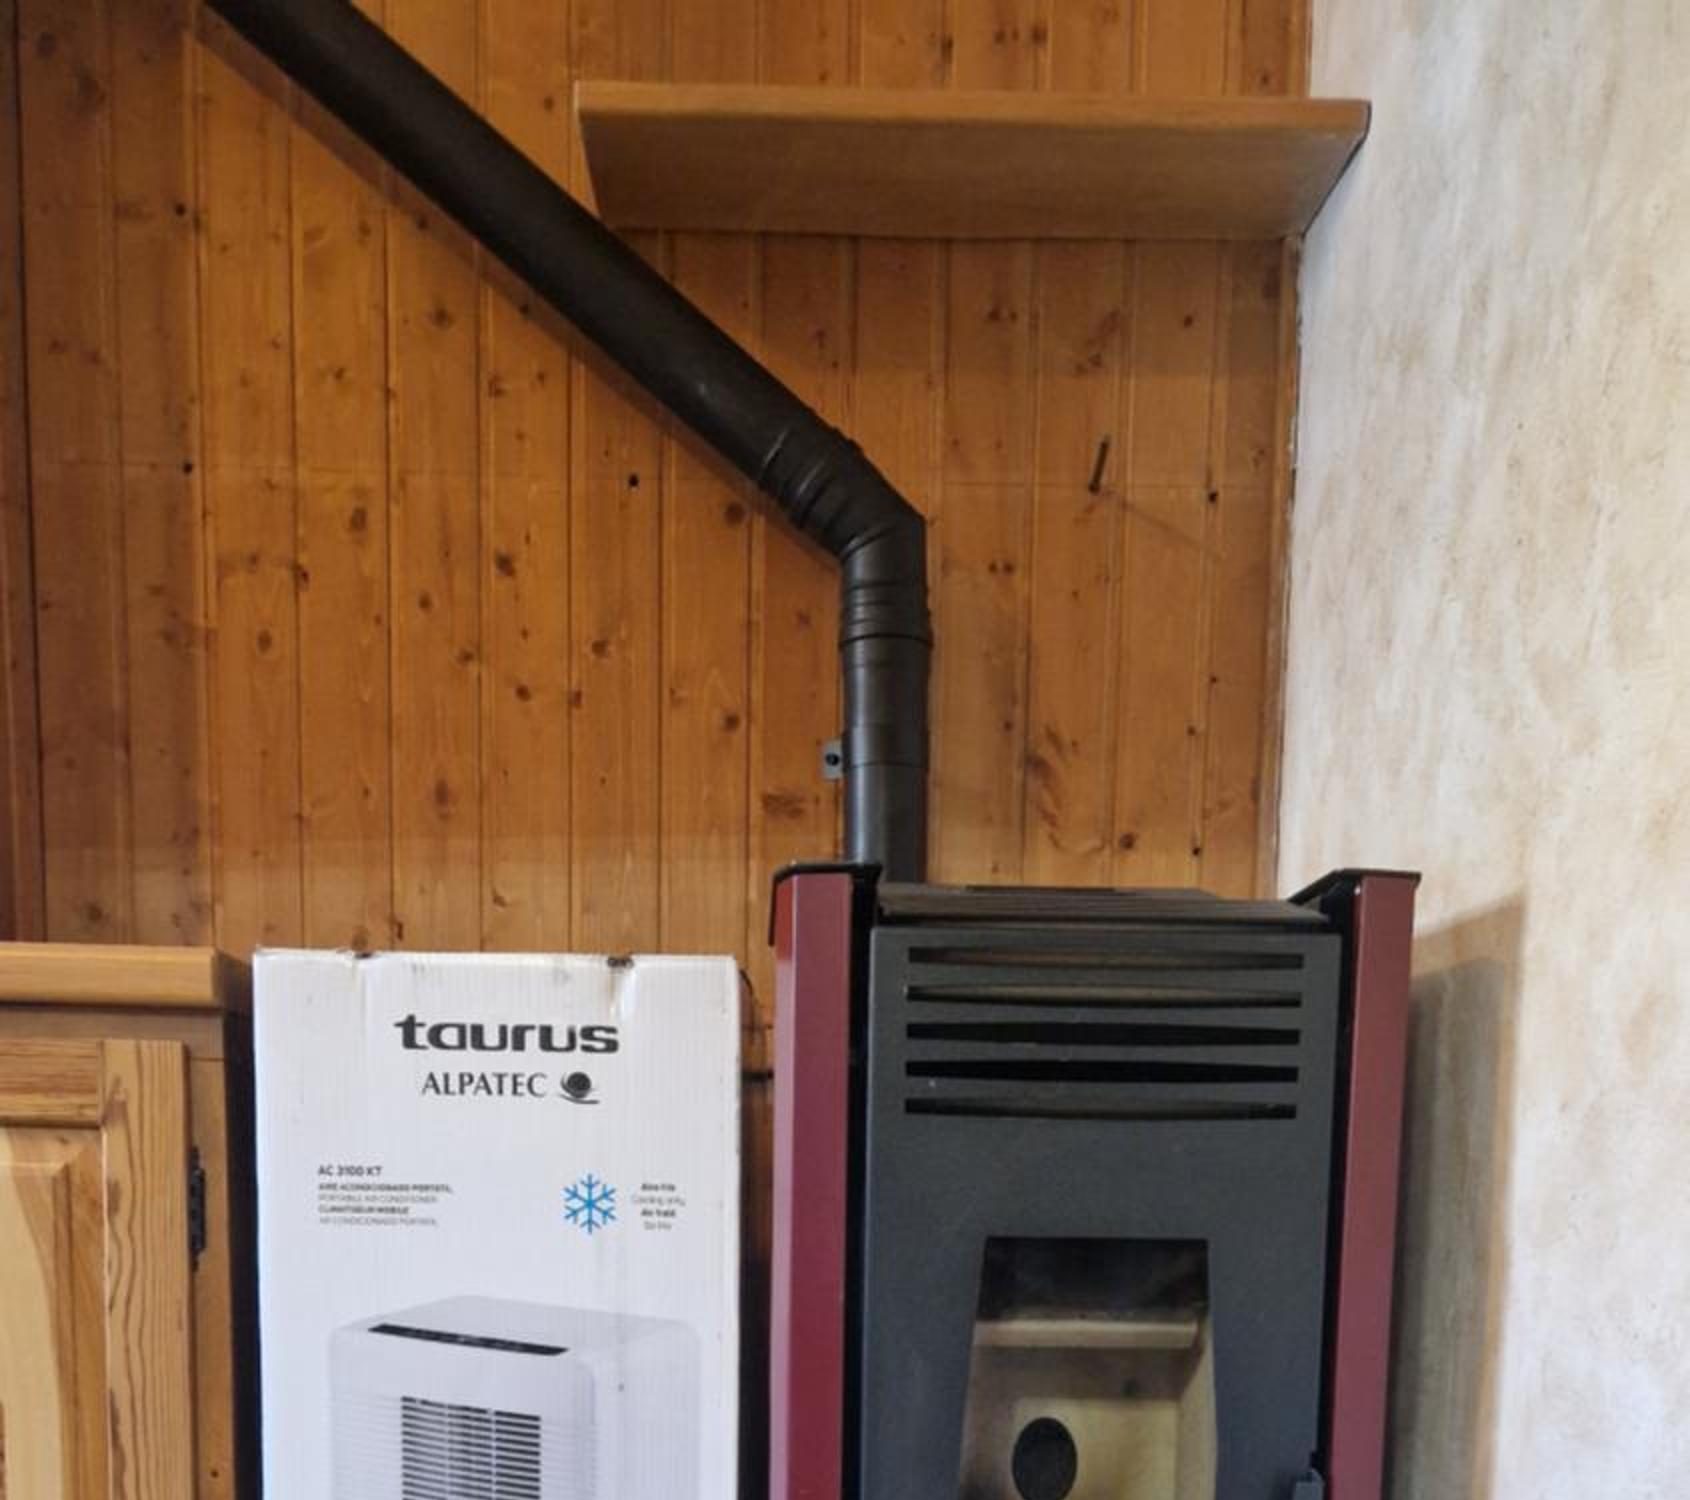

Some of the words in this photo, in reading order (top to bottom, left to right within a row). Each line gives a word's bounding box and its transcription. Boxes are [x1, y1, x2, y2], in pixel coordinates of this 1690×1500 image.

[393, 1014, 620, 1053] taurus
[422, 1071, 548, 1098] ALPATEC
[318, 1165, 334, 1176] AC
